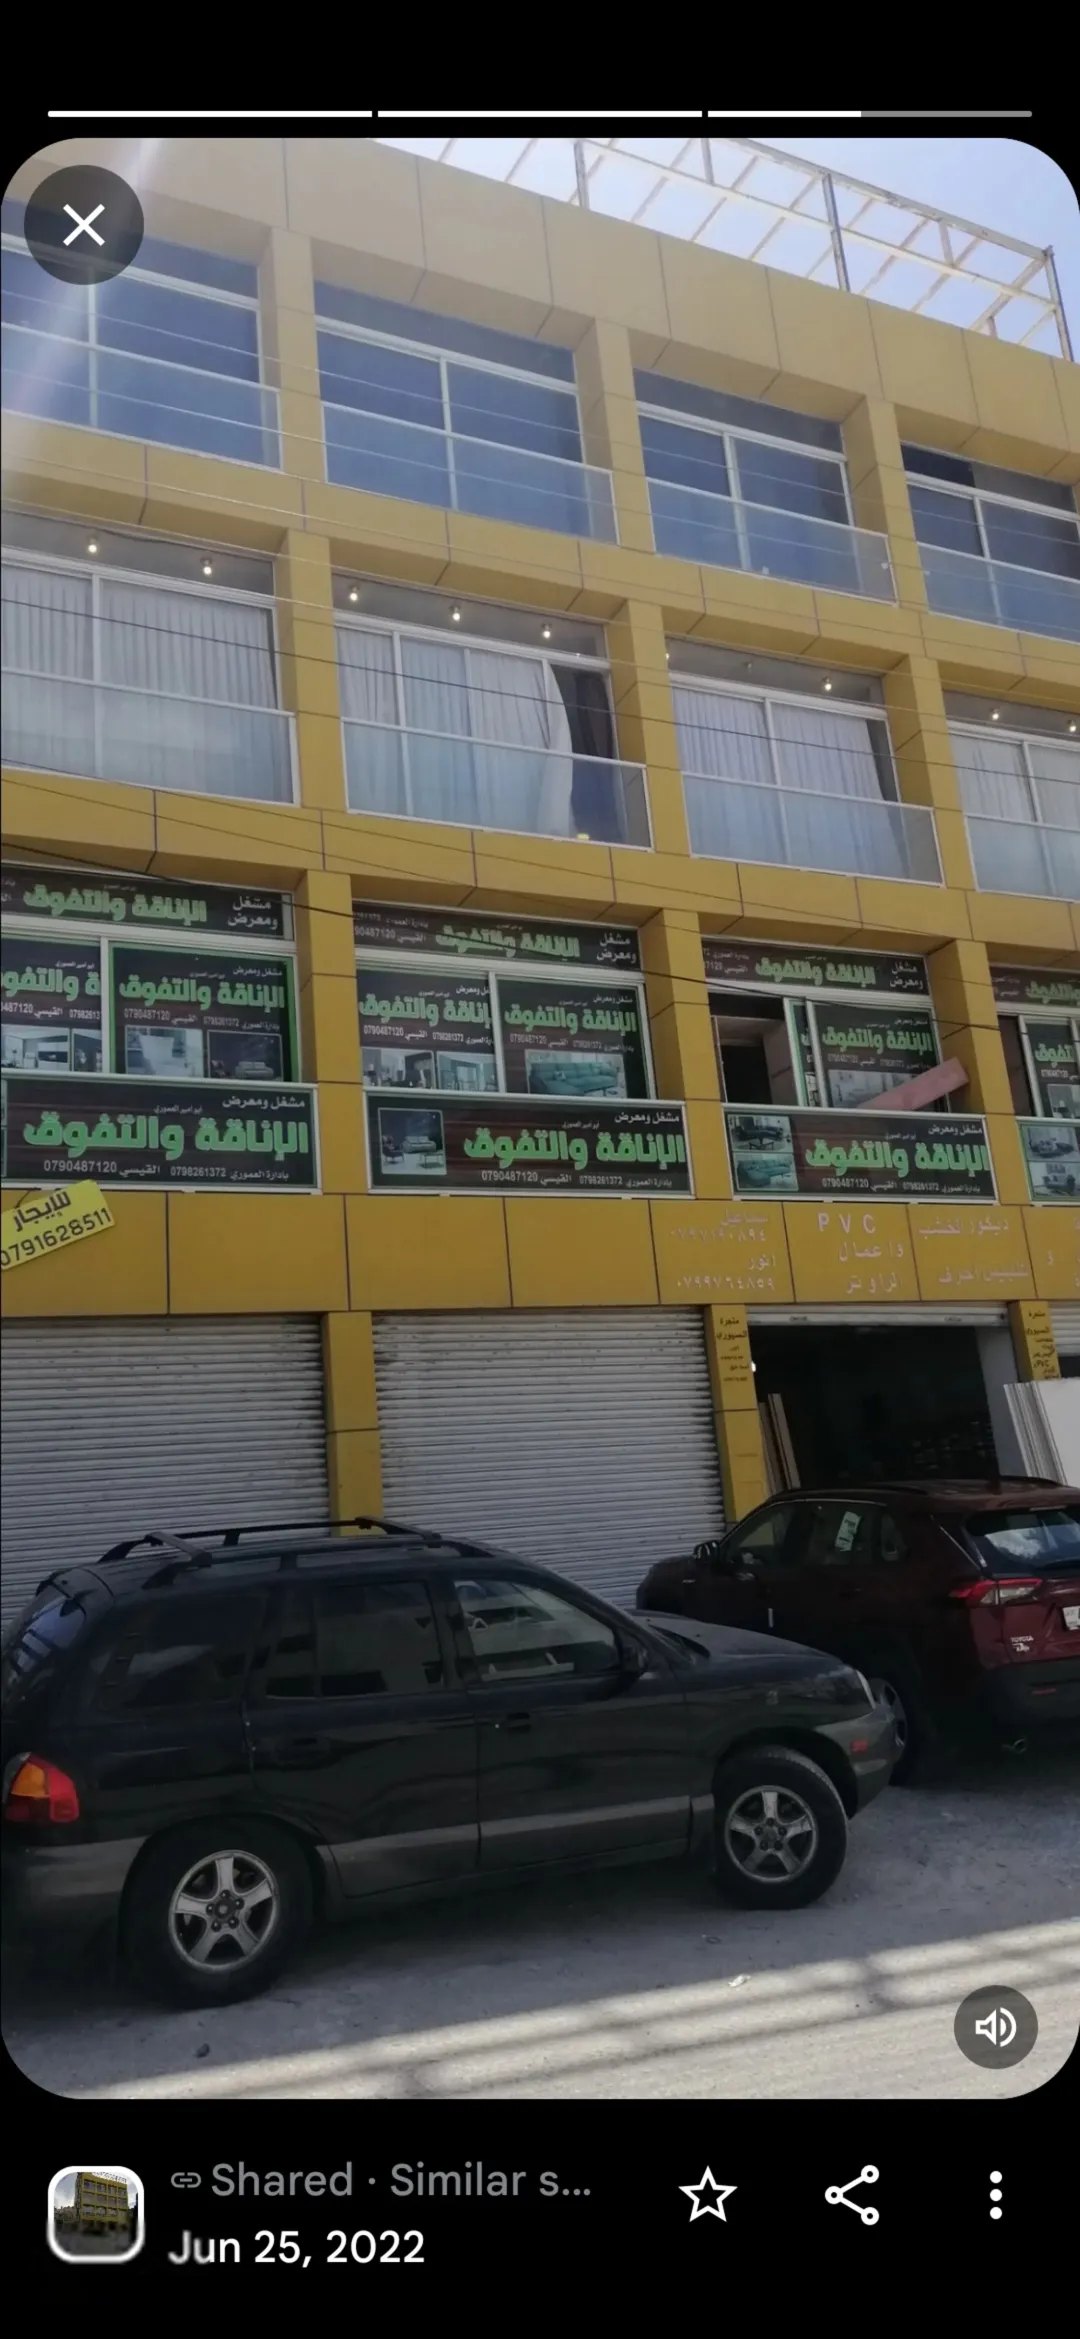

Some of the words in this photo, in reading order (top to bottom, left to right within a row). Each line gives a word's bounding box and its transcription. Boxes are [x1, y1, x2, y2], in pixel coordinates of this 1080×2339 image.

[1, 966, 79, 1001] والتفو
[23, 1111, 185, 1161] والتفوق
[464, 1127, 588, 1170] والتفوق
[44, 1159, 118, 1174] 0790487120
[170, 1166, 227, 1177] 0798261372
[481, 1170, 538, 1183] 0790487120
[805, 1139, 909, 1178] والتفوق
[1, 1207, 112, 1266] 0791628511
